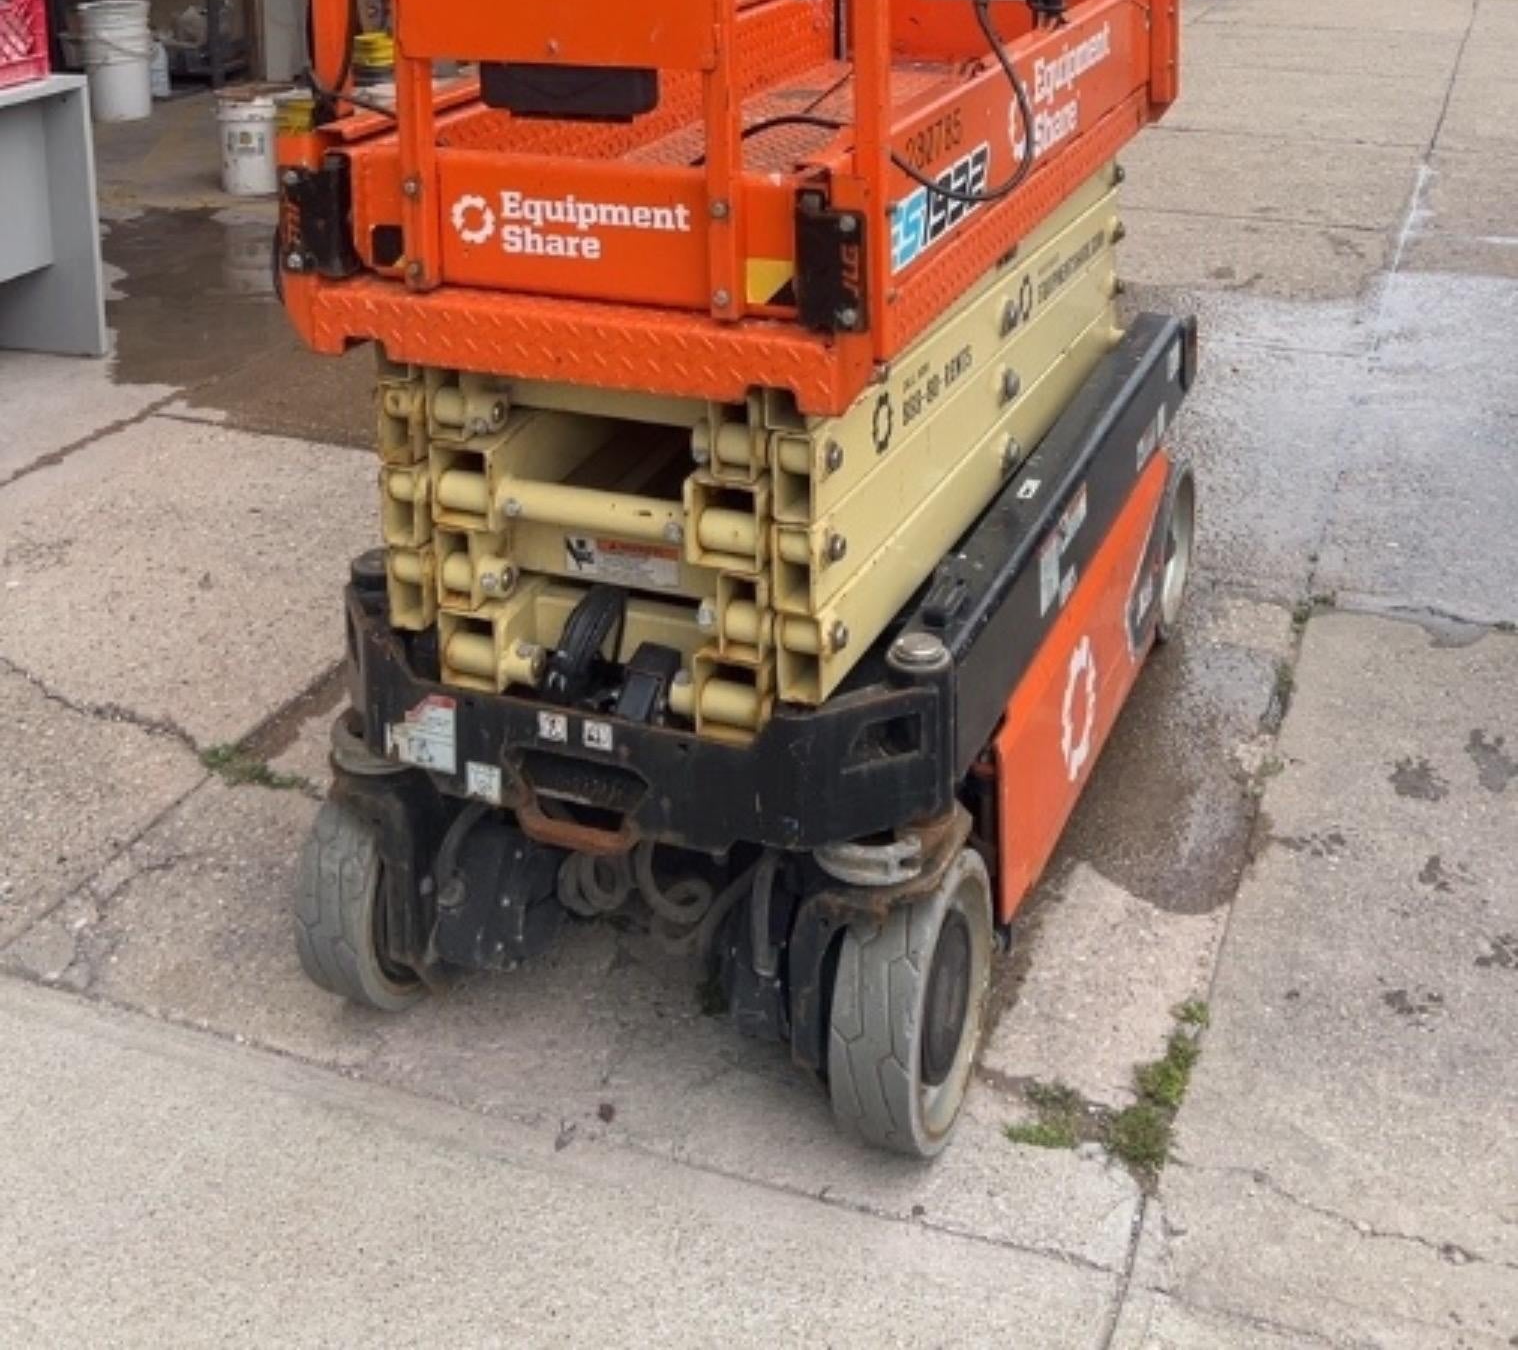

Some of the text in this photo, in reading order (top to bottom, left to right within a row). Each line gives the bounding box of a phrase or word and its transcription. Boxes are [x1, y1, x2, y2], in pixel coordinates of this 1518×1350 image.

[1033, 20, 1111, 105] Equipment
[1033, 98, 1079, 160] Share
[500, 191, 690, 232] Equipment
[500, 223, 601, 259] Share
